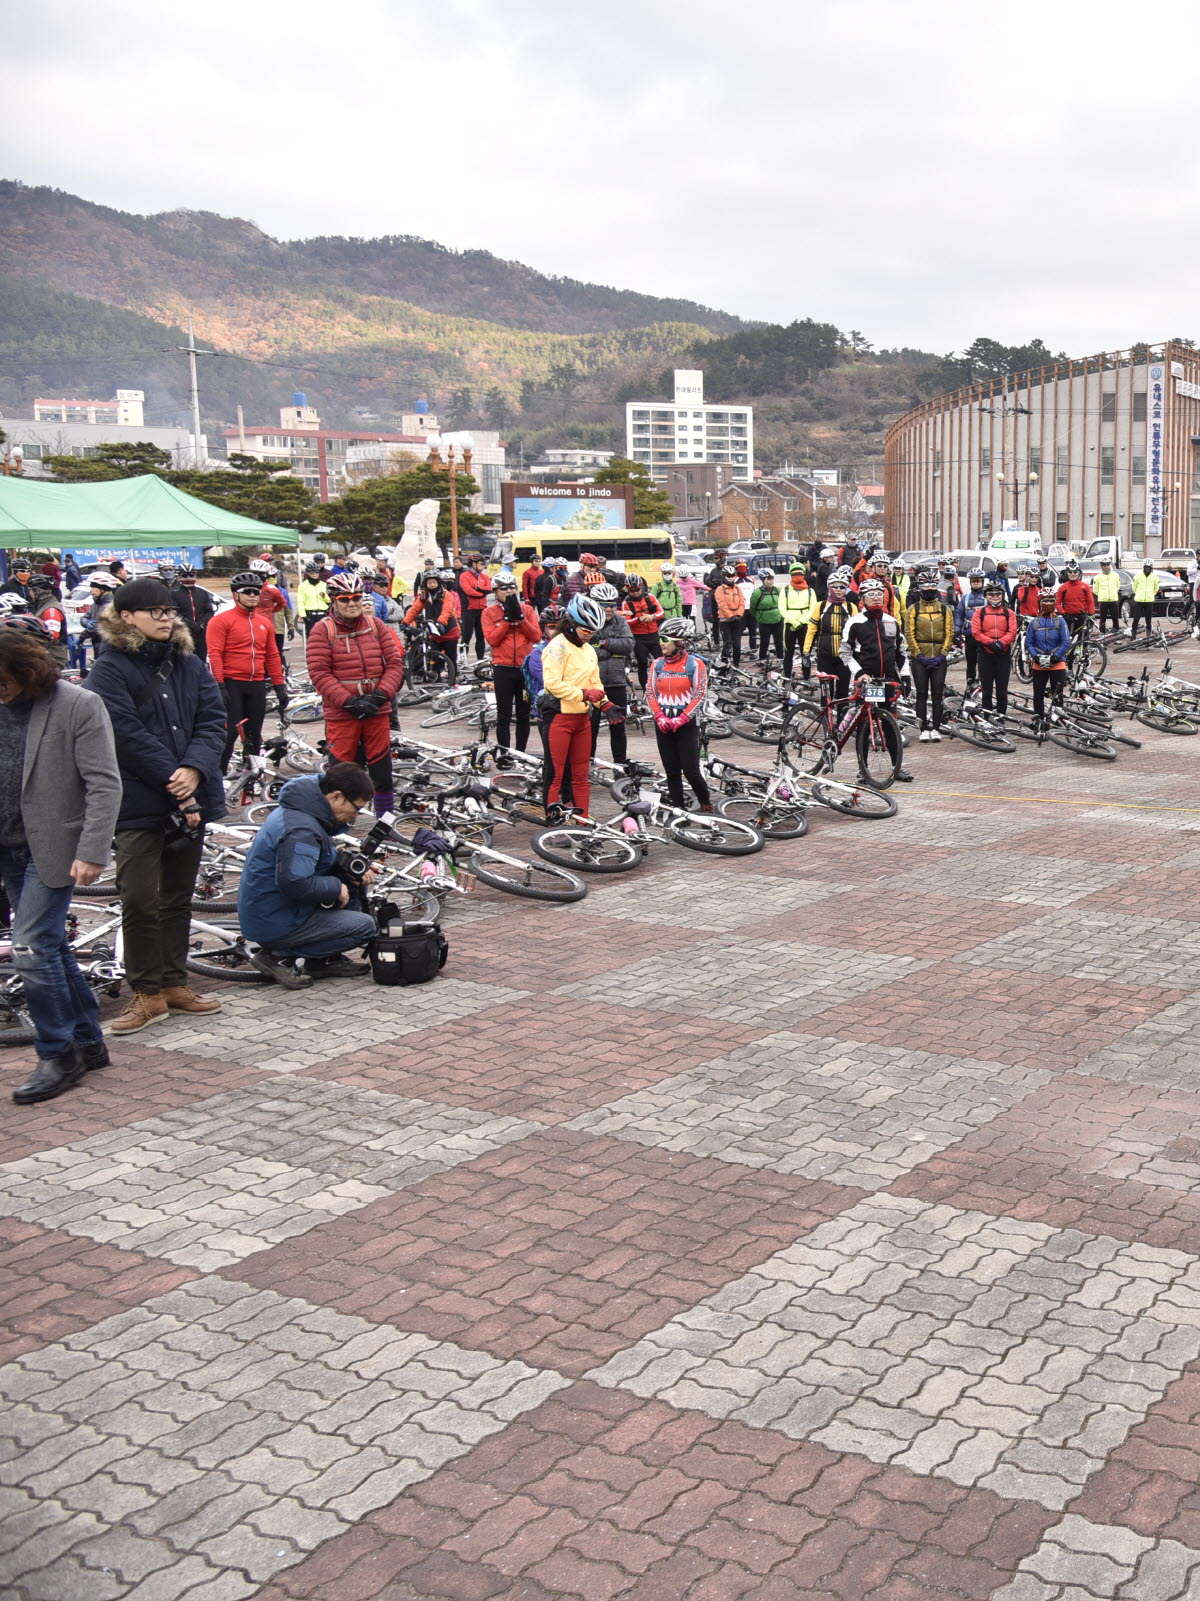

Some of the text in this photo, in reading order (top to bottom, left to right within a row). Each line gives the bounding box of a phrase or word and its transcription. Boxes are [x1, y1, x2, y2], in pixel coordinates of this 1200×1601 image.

[1152, 383, 1162, 419] 유네스코
[530, 486, 612, 498] Welcome to jindo
[866, 688, 883, 697] 578
